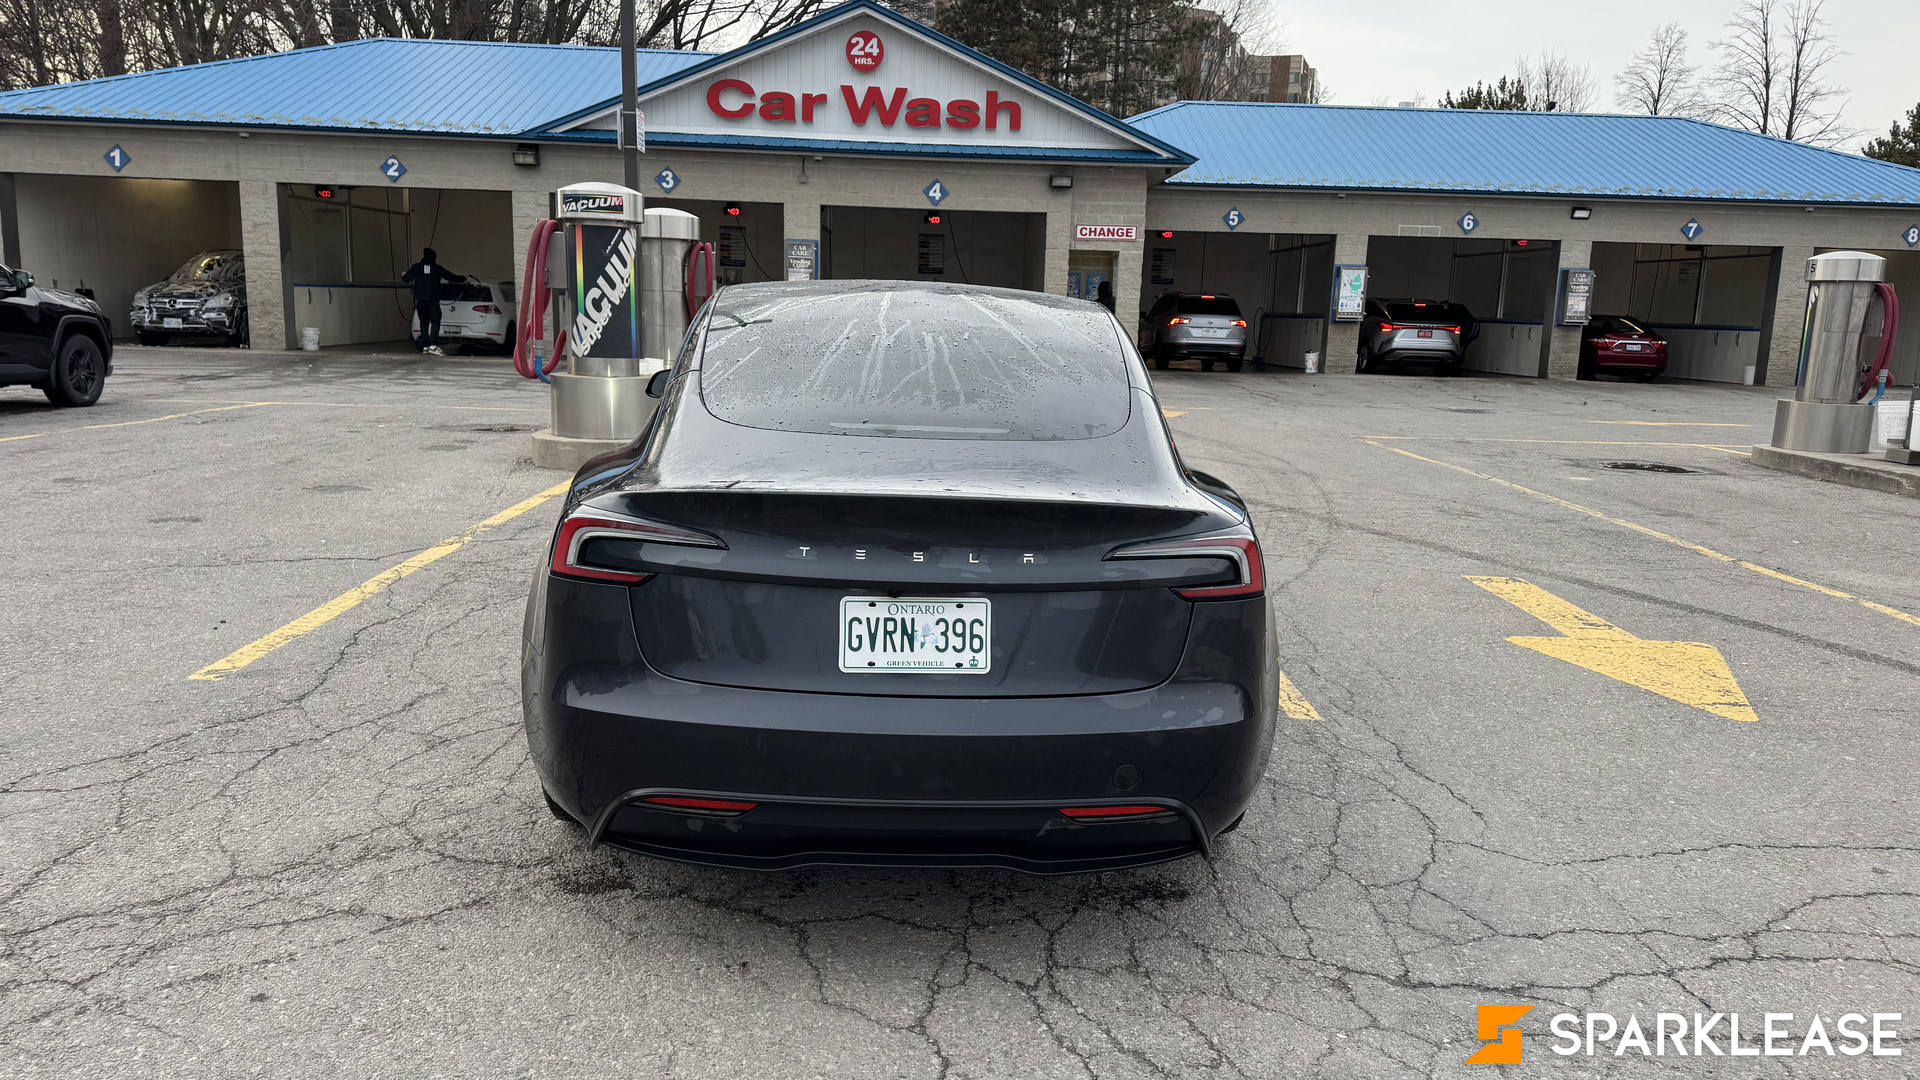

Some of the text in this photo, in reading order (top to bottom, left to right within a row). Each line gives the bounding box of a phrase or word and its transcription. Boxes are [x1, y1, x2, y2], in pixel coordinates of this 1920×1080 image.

[850, 37, 879, 56] 24
[854, 57, 875, 65] HRS.
[706, 78, 1022, 130] Car Wash
[110, 149, 120, 167] 1
[387, 158, 399, 176] 2
[661, 170, 674, 188] 3
[928, 182, 942, 200] 4
[562, 196, 623, 213] VACUUM
[1228, 210, 1239, 226] 5
[1463, 214, 1474, 230] 6
[1079, 226, 1134, 238] CHANGE
[1687, 223, 1698, 238] 7
[1908, 228, 1919, 243] 8
[1811, 263, 1816, 273] 5
[799, 546, 1034, 564] TESLA
[847, 617, 984, 654] GVRN 396
